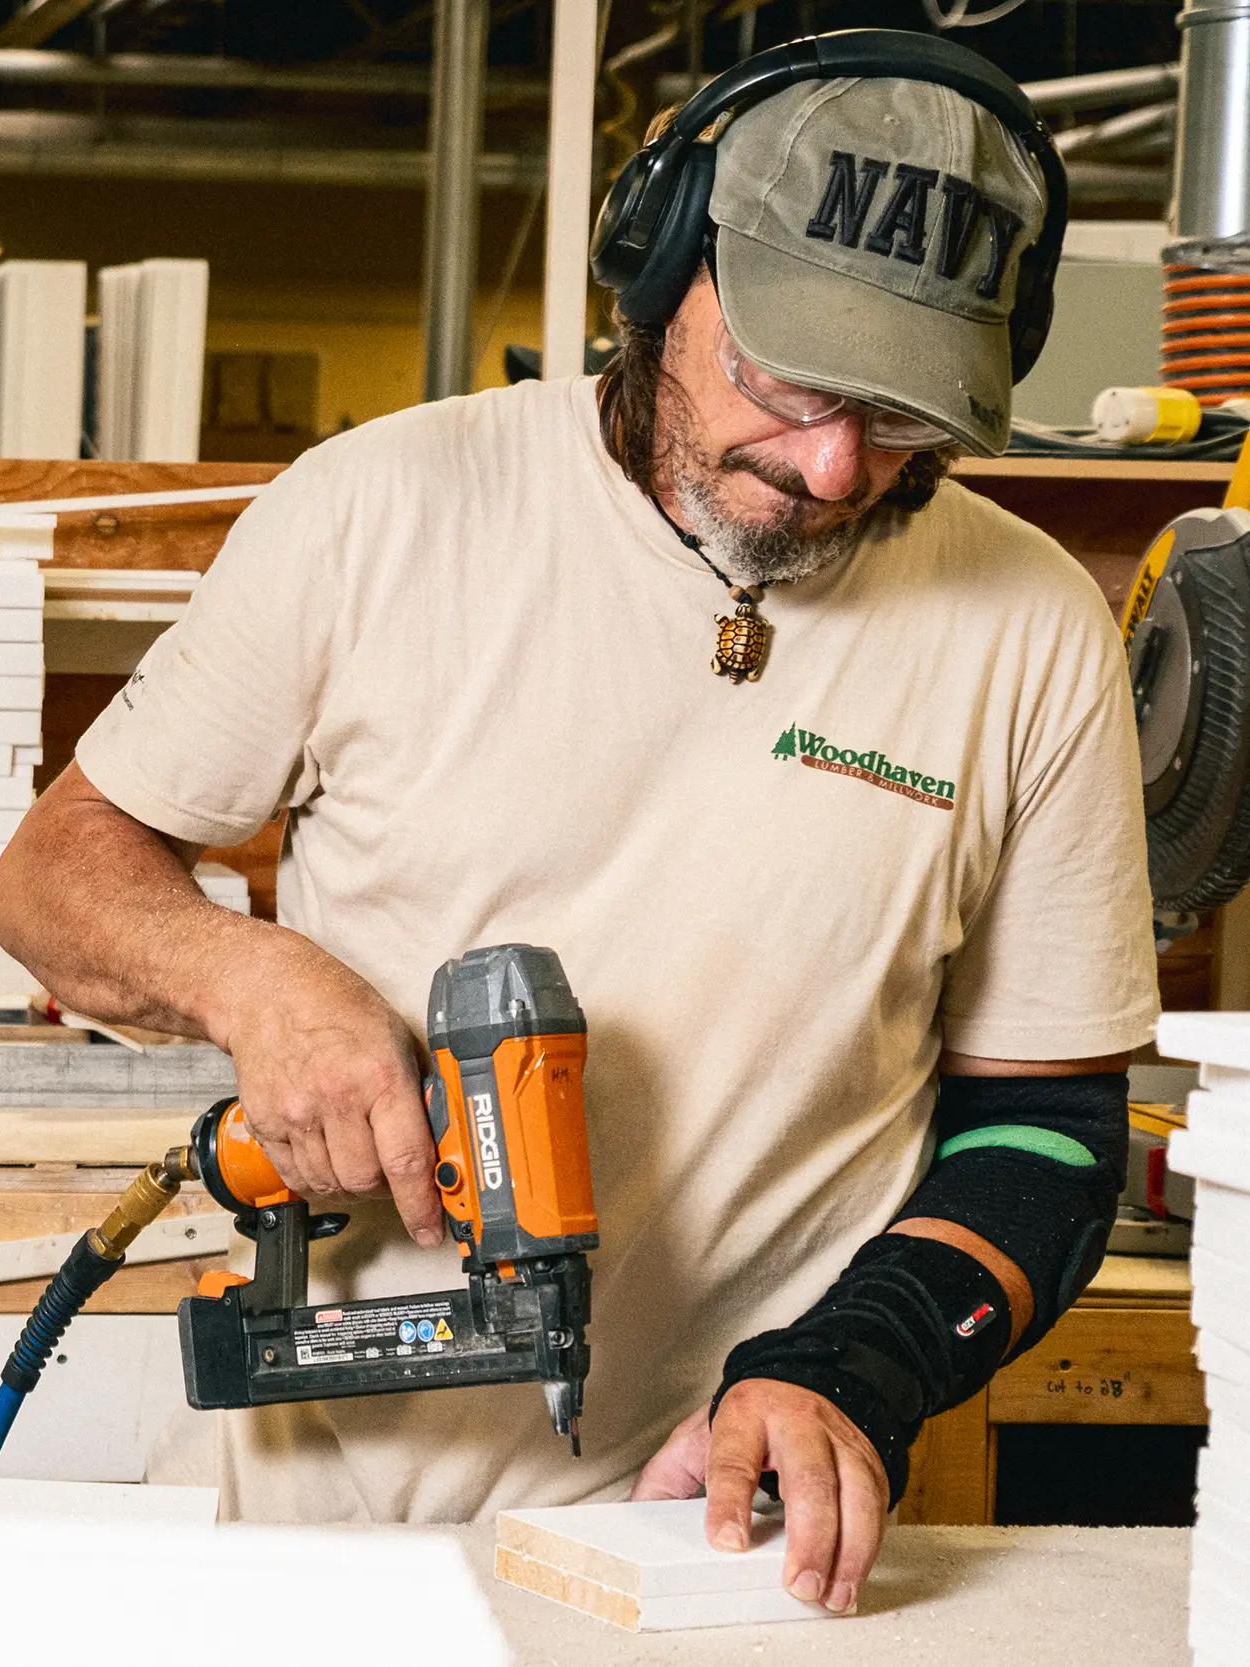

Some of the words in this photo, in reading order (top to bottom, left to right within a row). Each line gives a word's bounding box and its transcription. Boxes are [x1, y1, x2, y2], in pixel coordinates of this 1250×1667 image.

[805, 150, 1024, 300] NAVY
[797, 728, 956, 799] Woodhaven
[814, 759, 863, 778] LUMBER
[866, 773, 875, 783] &
[878, 778, 939, 807] MILLWORK
[472, 1092, 504, 1190] RIDGID
[1075, 1380, 1094, 1395] to
